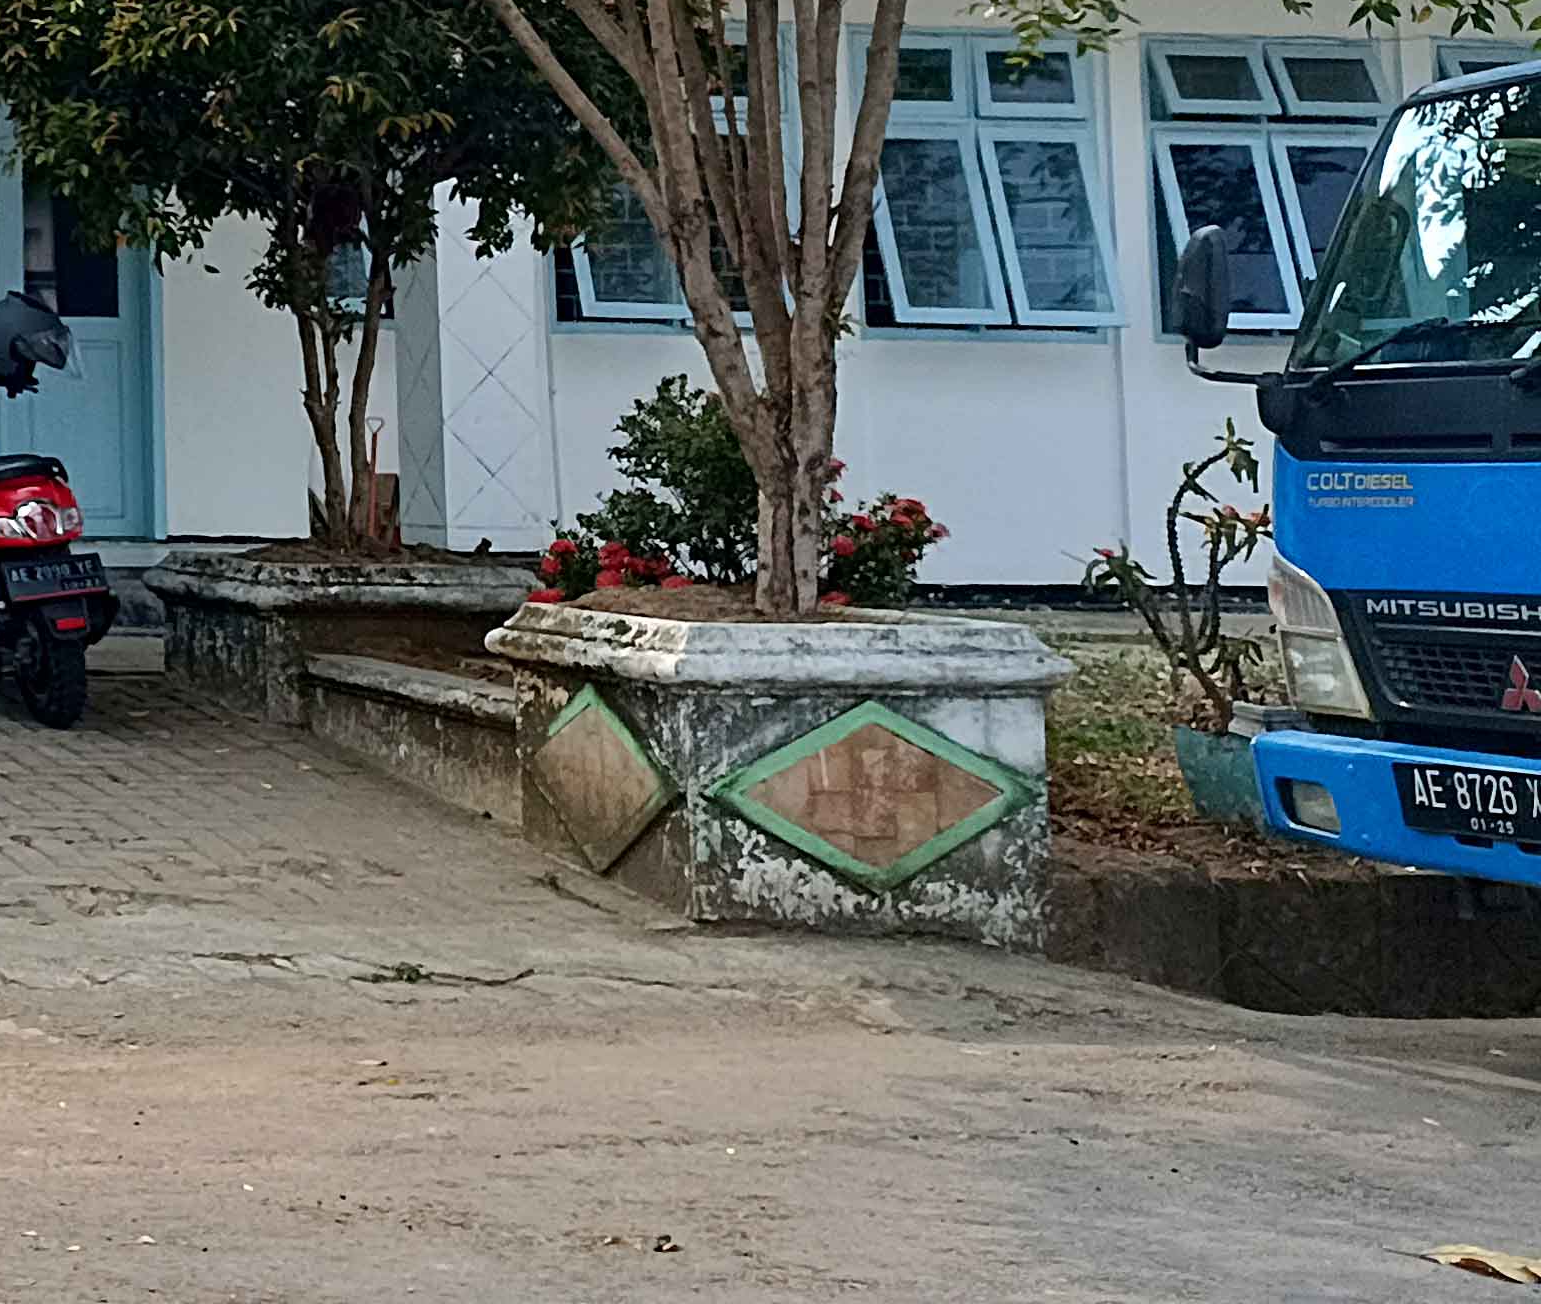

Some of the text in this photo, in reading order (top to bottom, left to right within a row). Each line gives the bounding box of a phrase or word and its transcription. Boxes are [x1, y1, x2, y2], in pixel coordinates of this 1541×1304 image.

[1307, 473, 1414, 491] COLT DIESEL
[1413, 768, 1447, 808] AE
[1453, 771, 1517, 815] 8726
